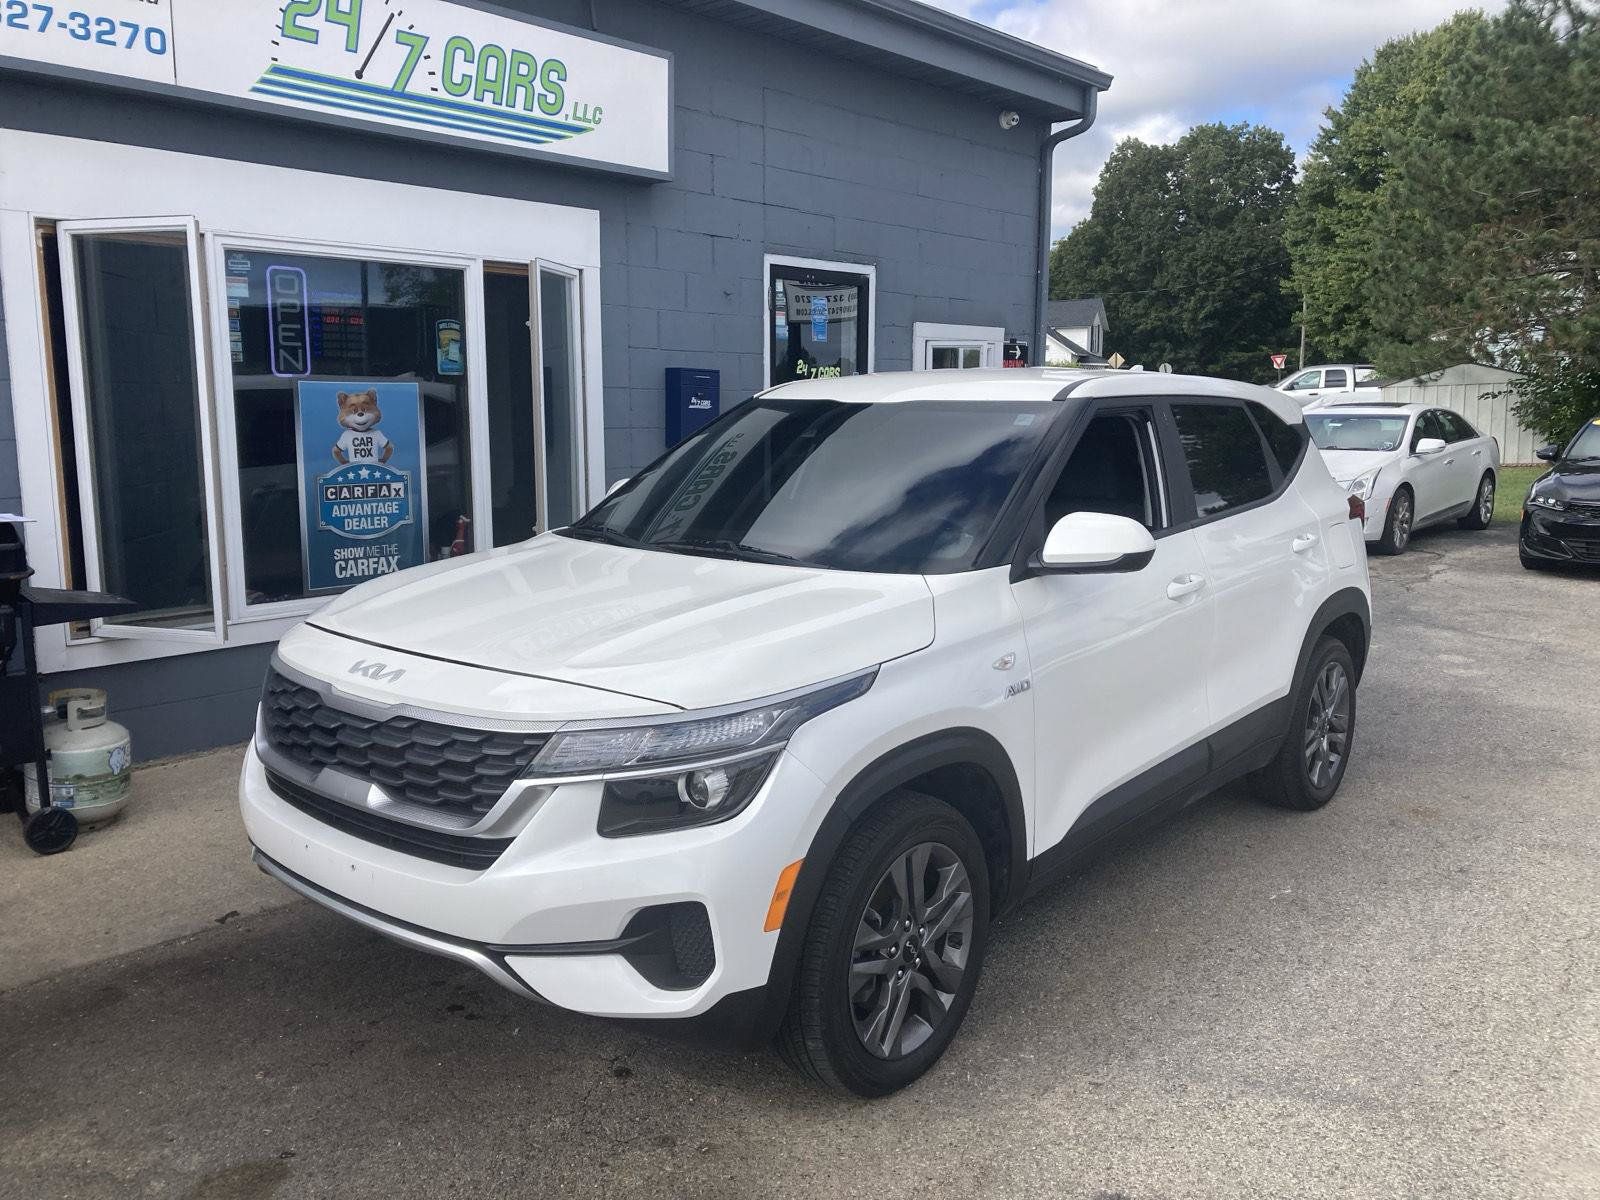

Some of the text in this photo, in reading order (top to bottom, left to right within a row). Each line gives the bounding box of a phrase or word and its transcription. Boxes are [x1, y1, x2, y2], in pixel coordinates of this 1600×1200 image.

[0, 0, 167, 55] 27-3270
[275, 273, 305, 372] OPEN
[352, 436, 373, 448] CAR
[353, 447, 374, 459] FOX
[325, 484, 404, 501] CARFAX
[332, 501, 400, 518] ADVANTAGE
[344, 516, 389, 531] DEALER
[333, 543, 399, 561] SHOW ME THE
[335, 555, 400, 579] CARFAX
[348, 659, 407, 683] KIA
